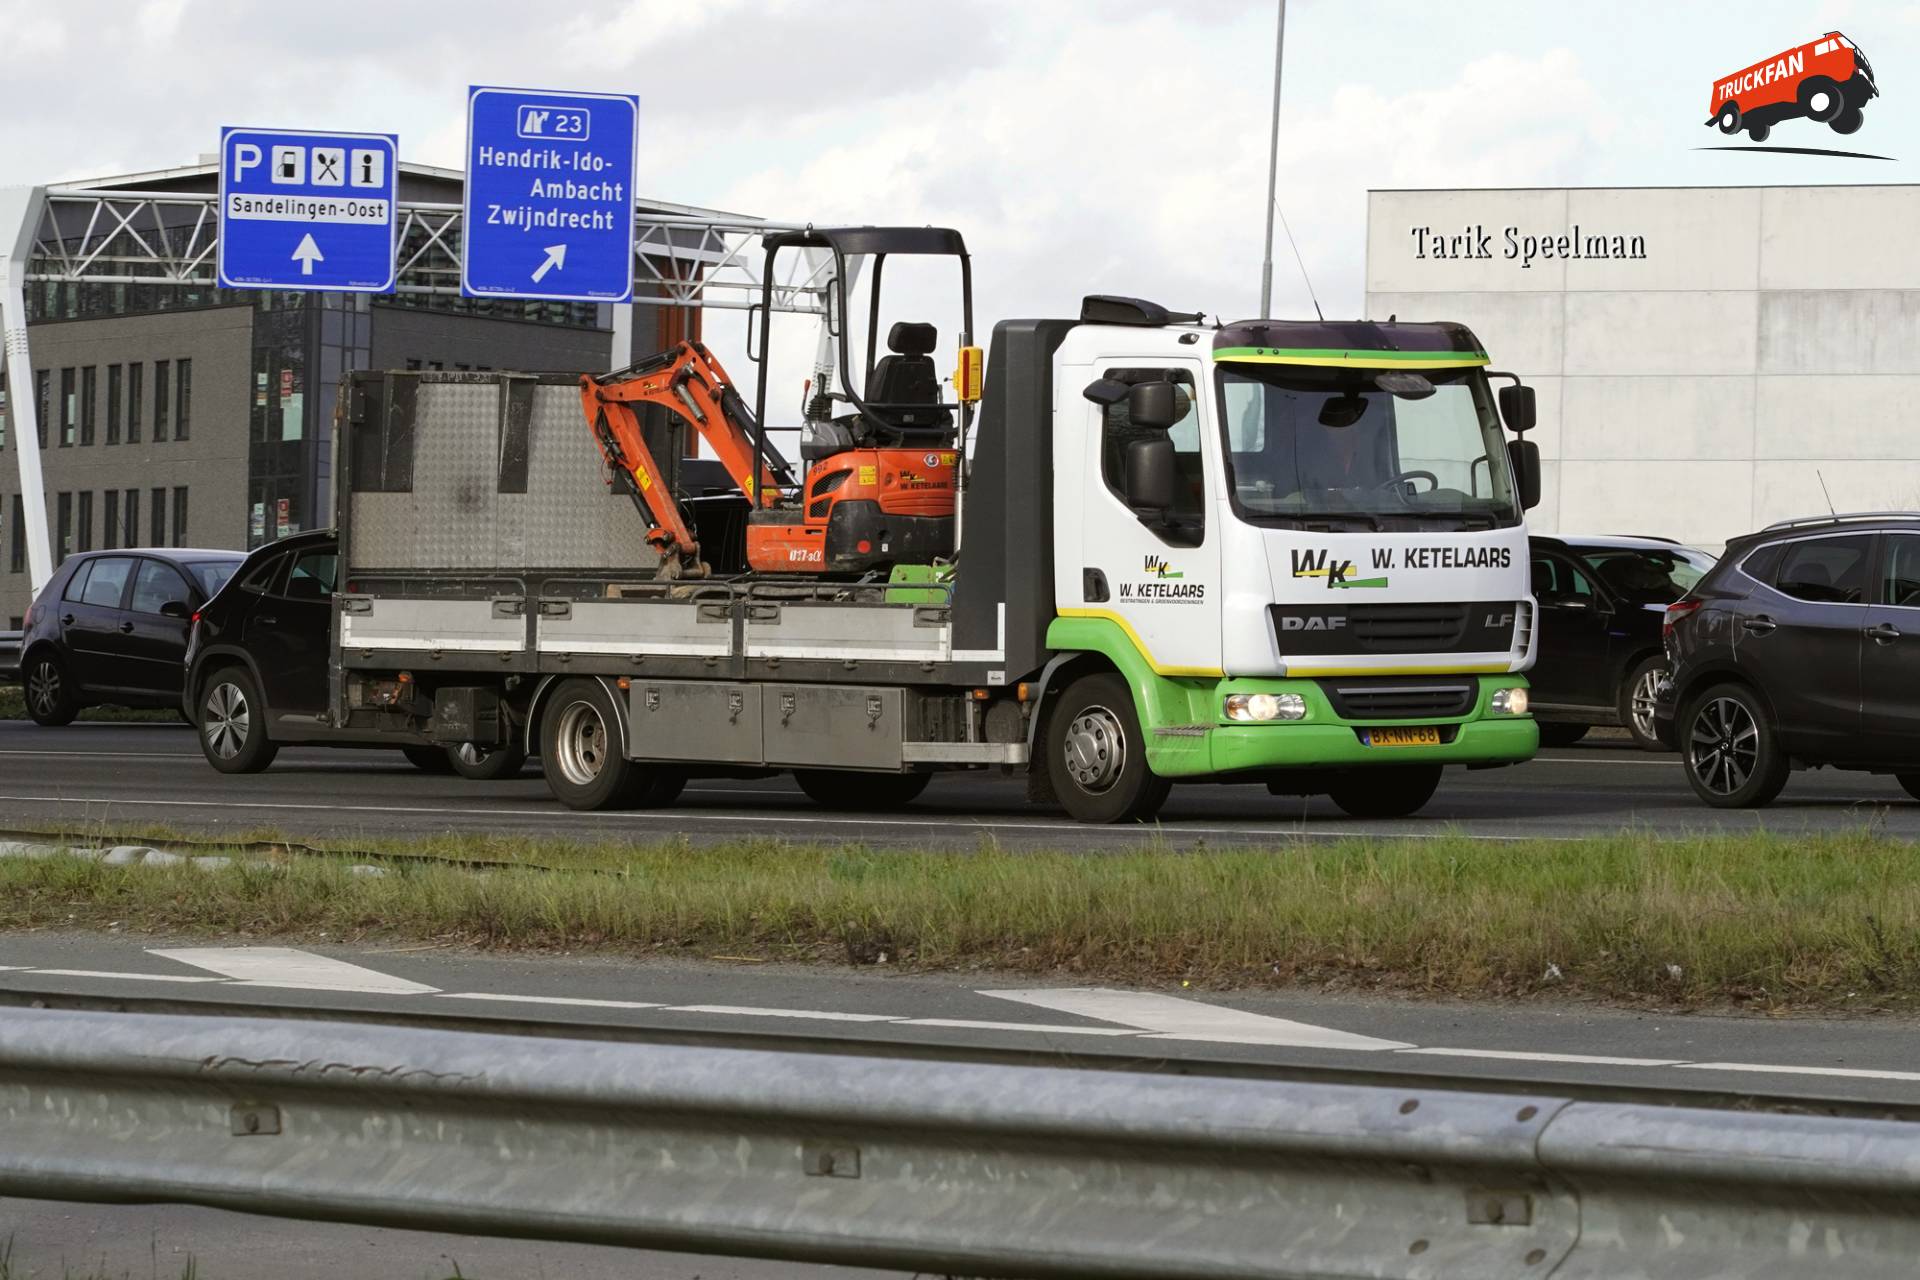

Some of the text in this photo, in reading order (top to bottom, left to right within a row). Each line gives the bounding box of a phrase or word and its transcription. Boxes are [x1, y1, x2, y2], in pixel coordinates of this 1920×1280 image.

[555, 115, 582, 133] 23
[234, 143, 262, 183] P
[479, 146, 612, 171] Hendrik-Ido-
[530, 178, 623, 201] Ambacht
[232, 197, 384, 219] Sandelingen-Oost
[487, 204, 614, 232] Zwijndrecht
[1371, 547, 1511, 569] W. KETELAARS
[1119, 583, 1205, 598] W. KETELAARS
[1281, 616, 1347, 631] DAF
[1484, 614, 1513, 628] LF
